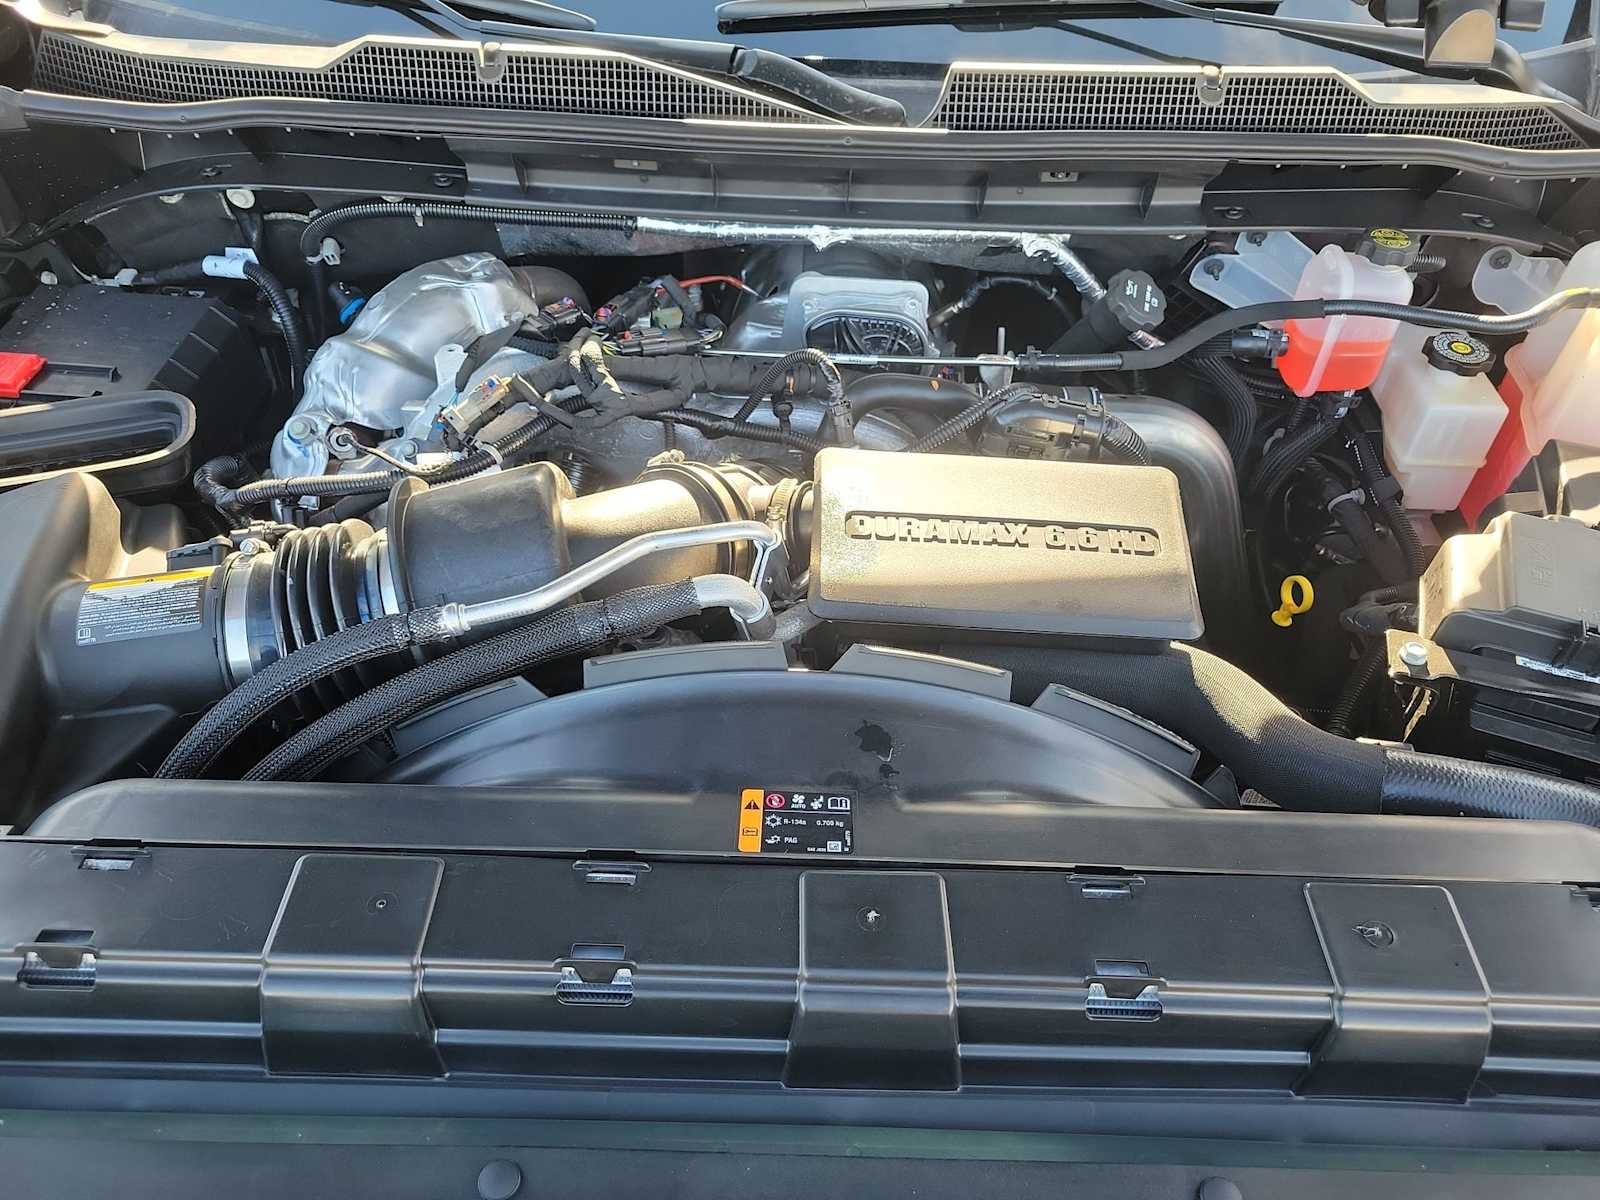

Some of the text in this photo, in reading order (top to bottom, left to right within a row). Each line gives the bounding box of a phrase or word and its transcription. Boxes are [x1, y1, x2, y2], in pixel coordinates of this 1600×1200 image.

[848, 515, 1157, 556] DURAMAX 6.6 HD
[783, 818, 807, 826] R-134a
[835, 820, 844, 828] kg
